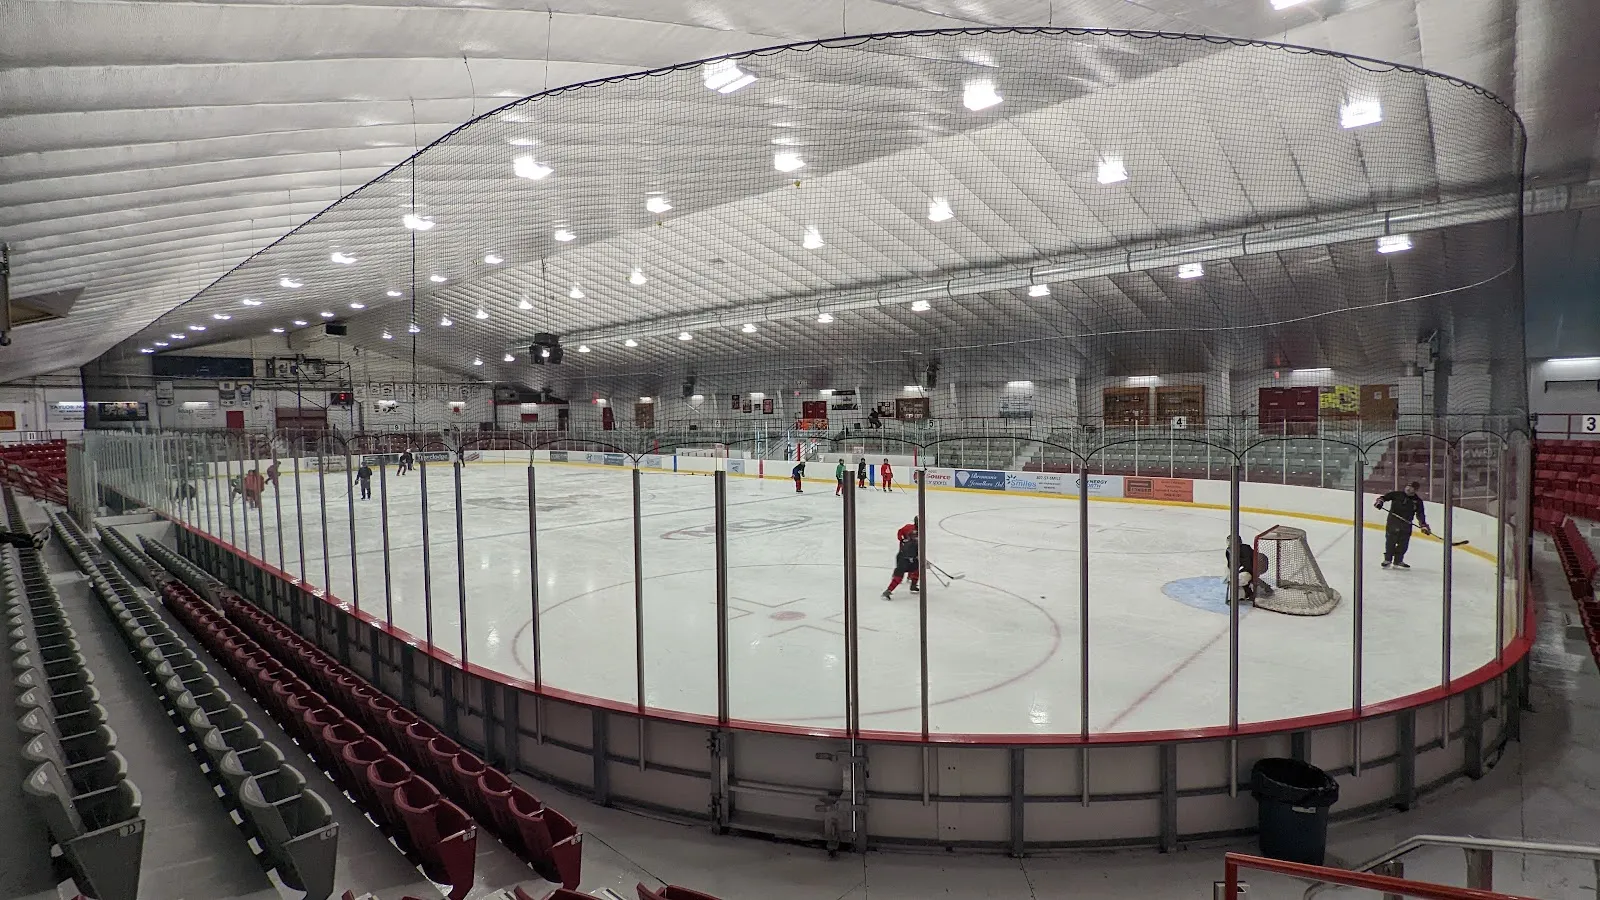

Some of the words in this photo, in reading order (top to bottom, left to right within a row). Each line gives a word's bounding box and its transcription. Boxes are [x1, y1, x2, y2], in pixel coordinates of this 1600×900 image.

[1177, 417, 1183, 427] 4
[1587, 417, 1596, 431] 3
[926, 473, 951, 481] Source
[1010, 479, 1037, 487] Smiles
